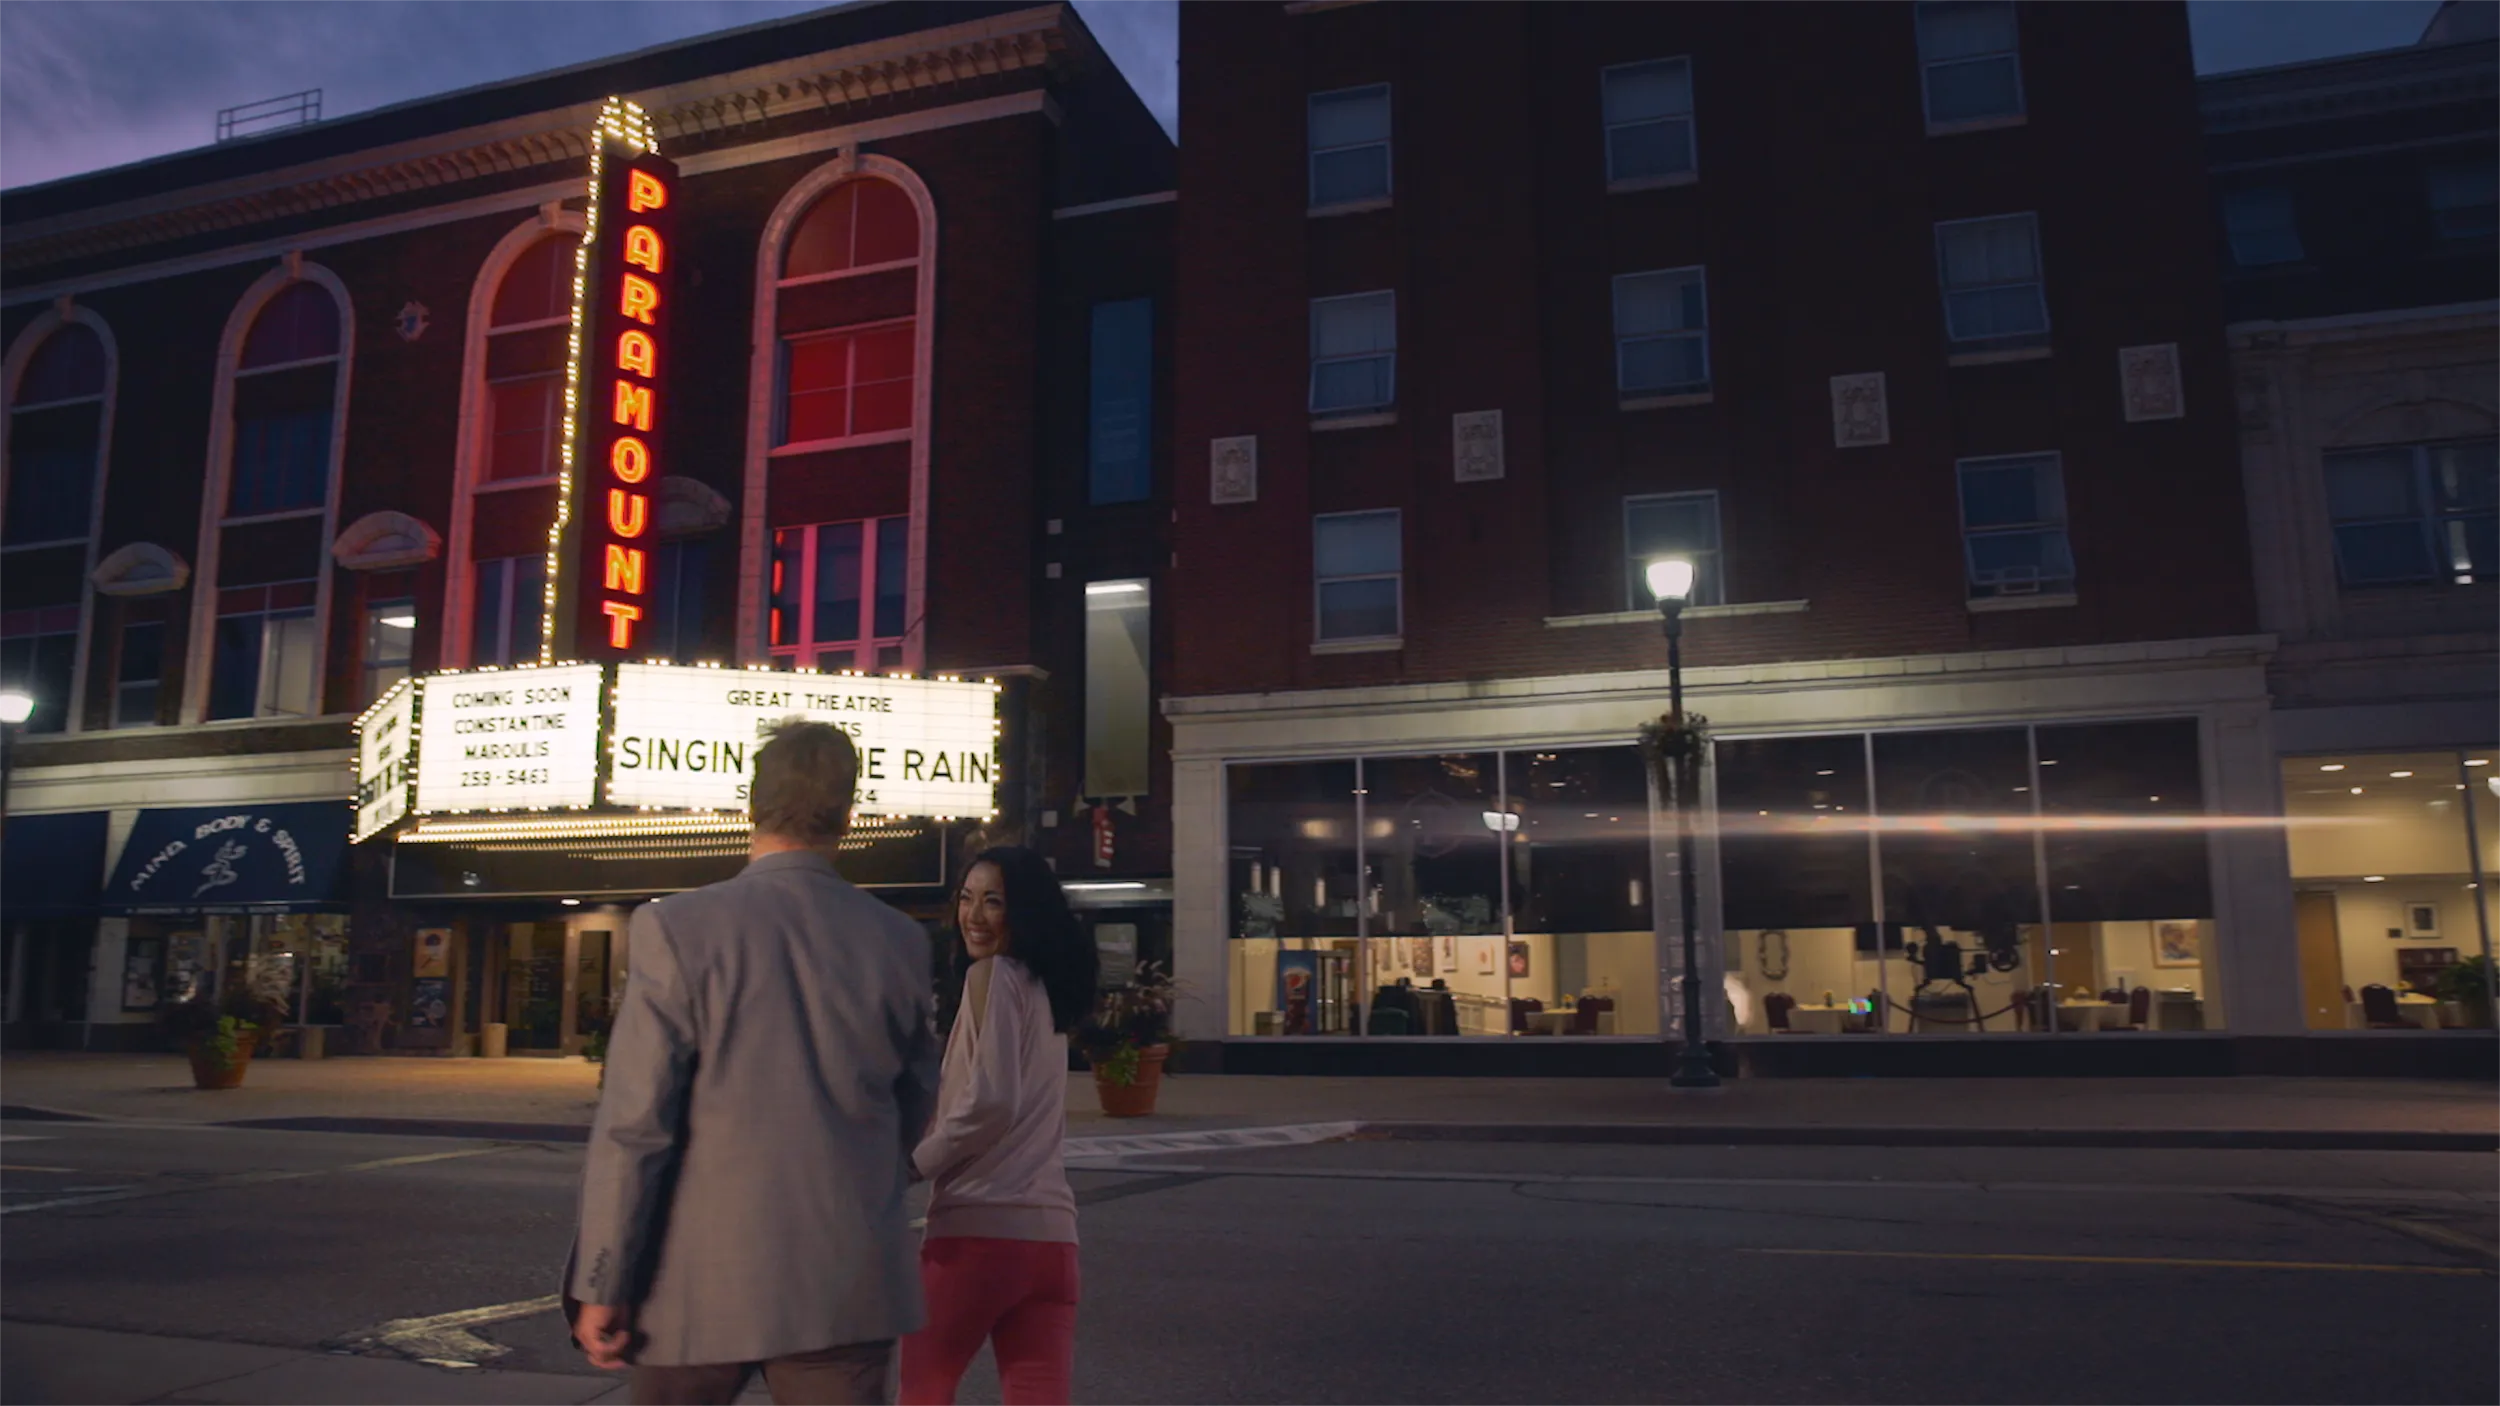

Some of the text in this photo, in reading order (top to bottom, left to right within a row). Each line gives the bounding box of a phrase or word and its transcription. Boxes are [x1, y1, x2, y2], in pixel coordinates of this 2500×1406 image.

[602, 168, 669, 651] PARAMOUNT
[453, 687, 571, 708] COMING SOON
[727, 690, 893, 713] GREAT THEATRE
[454, 713, 566, 734] CONSTANTINE
[464, 741, 549, 759] MAROULIS
[620, 736, 744, 774] SINGIN
[904, 749, 989, 783] RAIN
[130, 815, 305, 891] MIND BODY & SPIRIT
